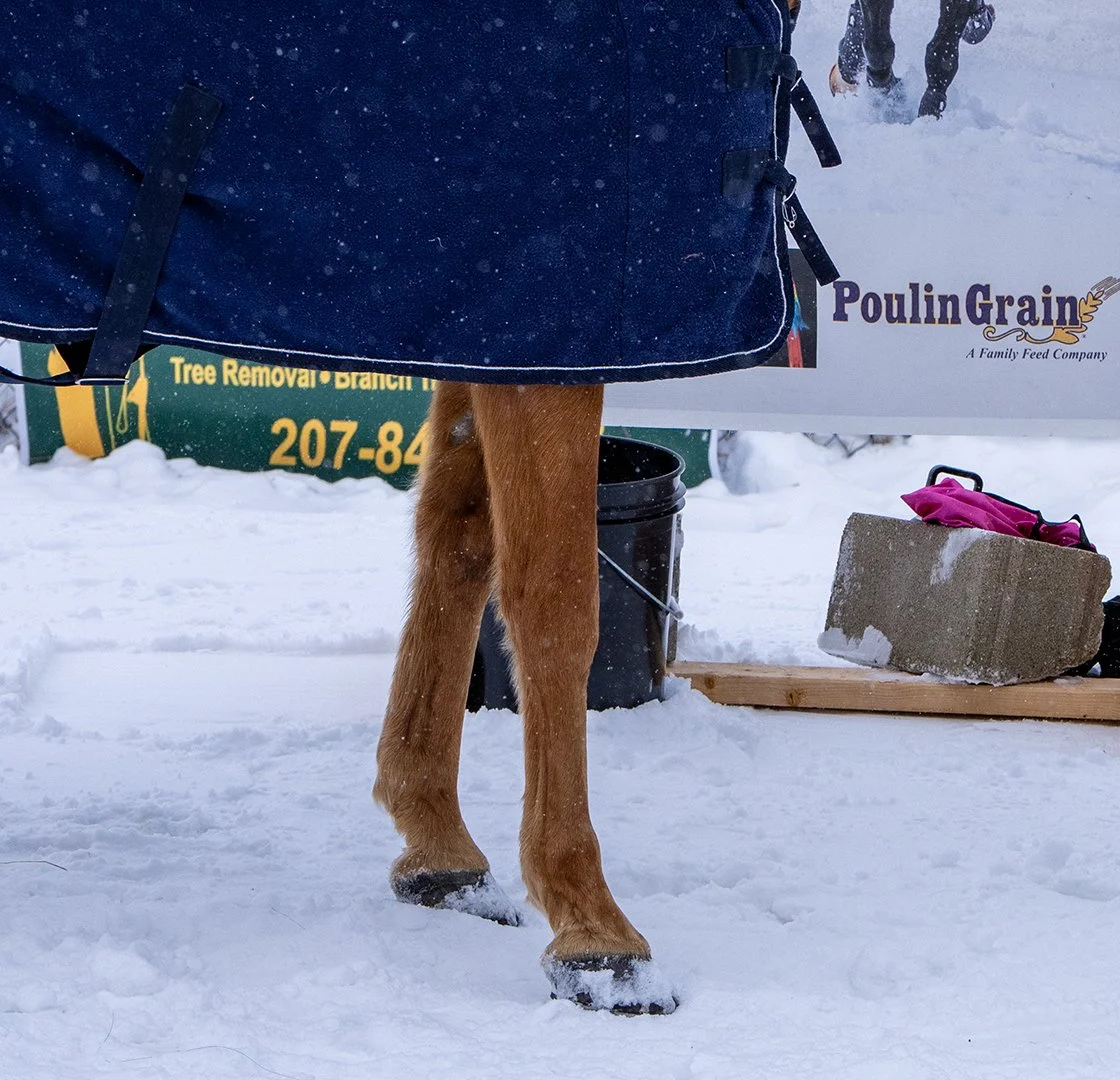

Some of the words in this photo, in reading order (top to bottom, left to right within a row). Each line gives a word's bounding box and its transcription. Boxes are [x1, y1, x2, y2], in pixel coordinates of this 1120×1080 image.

[832, 280, 1081, 327] PoulinGrain
[965, 348, 976, 360] A
[979, 347, 1018, 362] Family
[1022, 348, 1050, 360] Feed
[1053, 348, 1108, 363] Company
[169, 356, 216, 385] Tree
[222, 358, 316, 388] Removal
